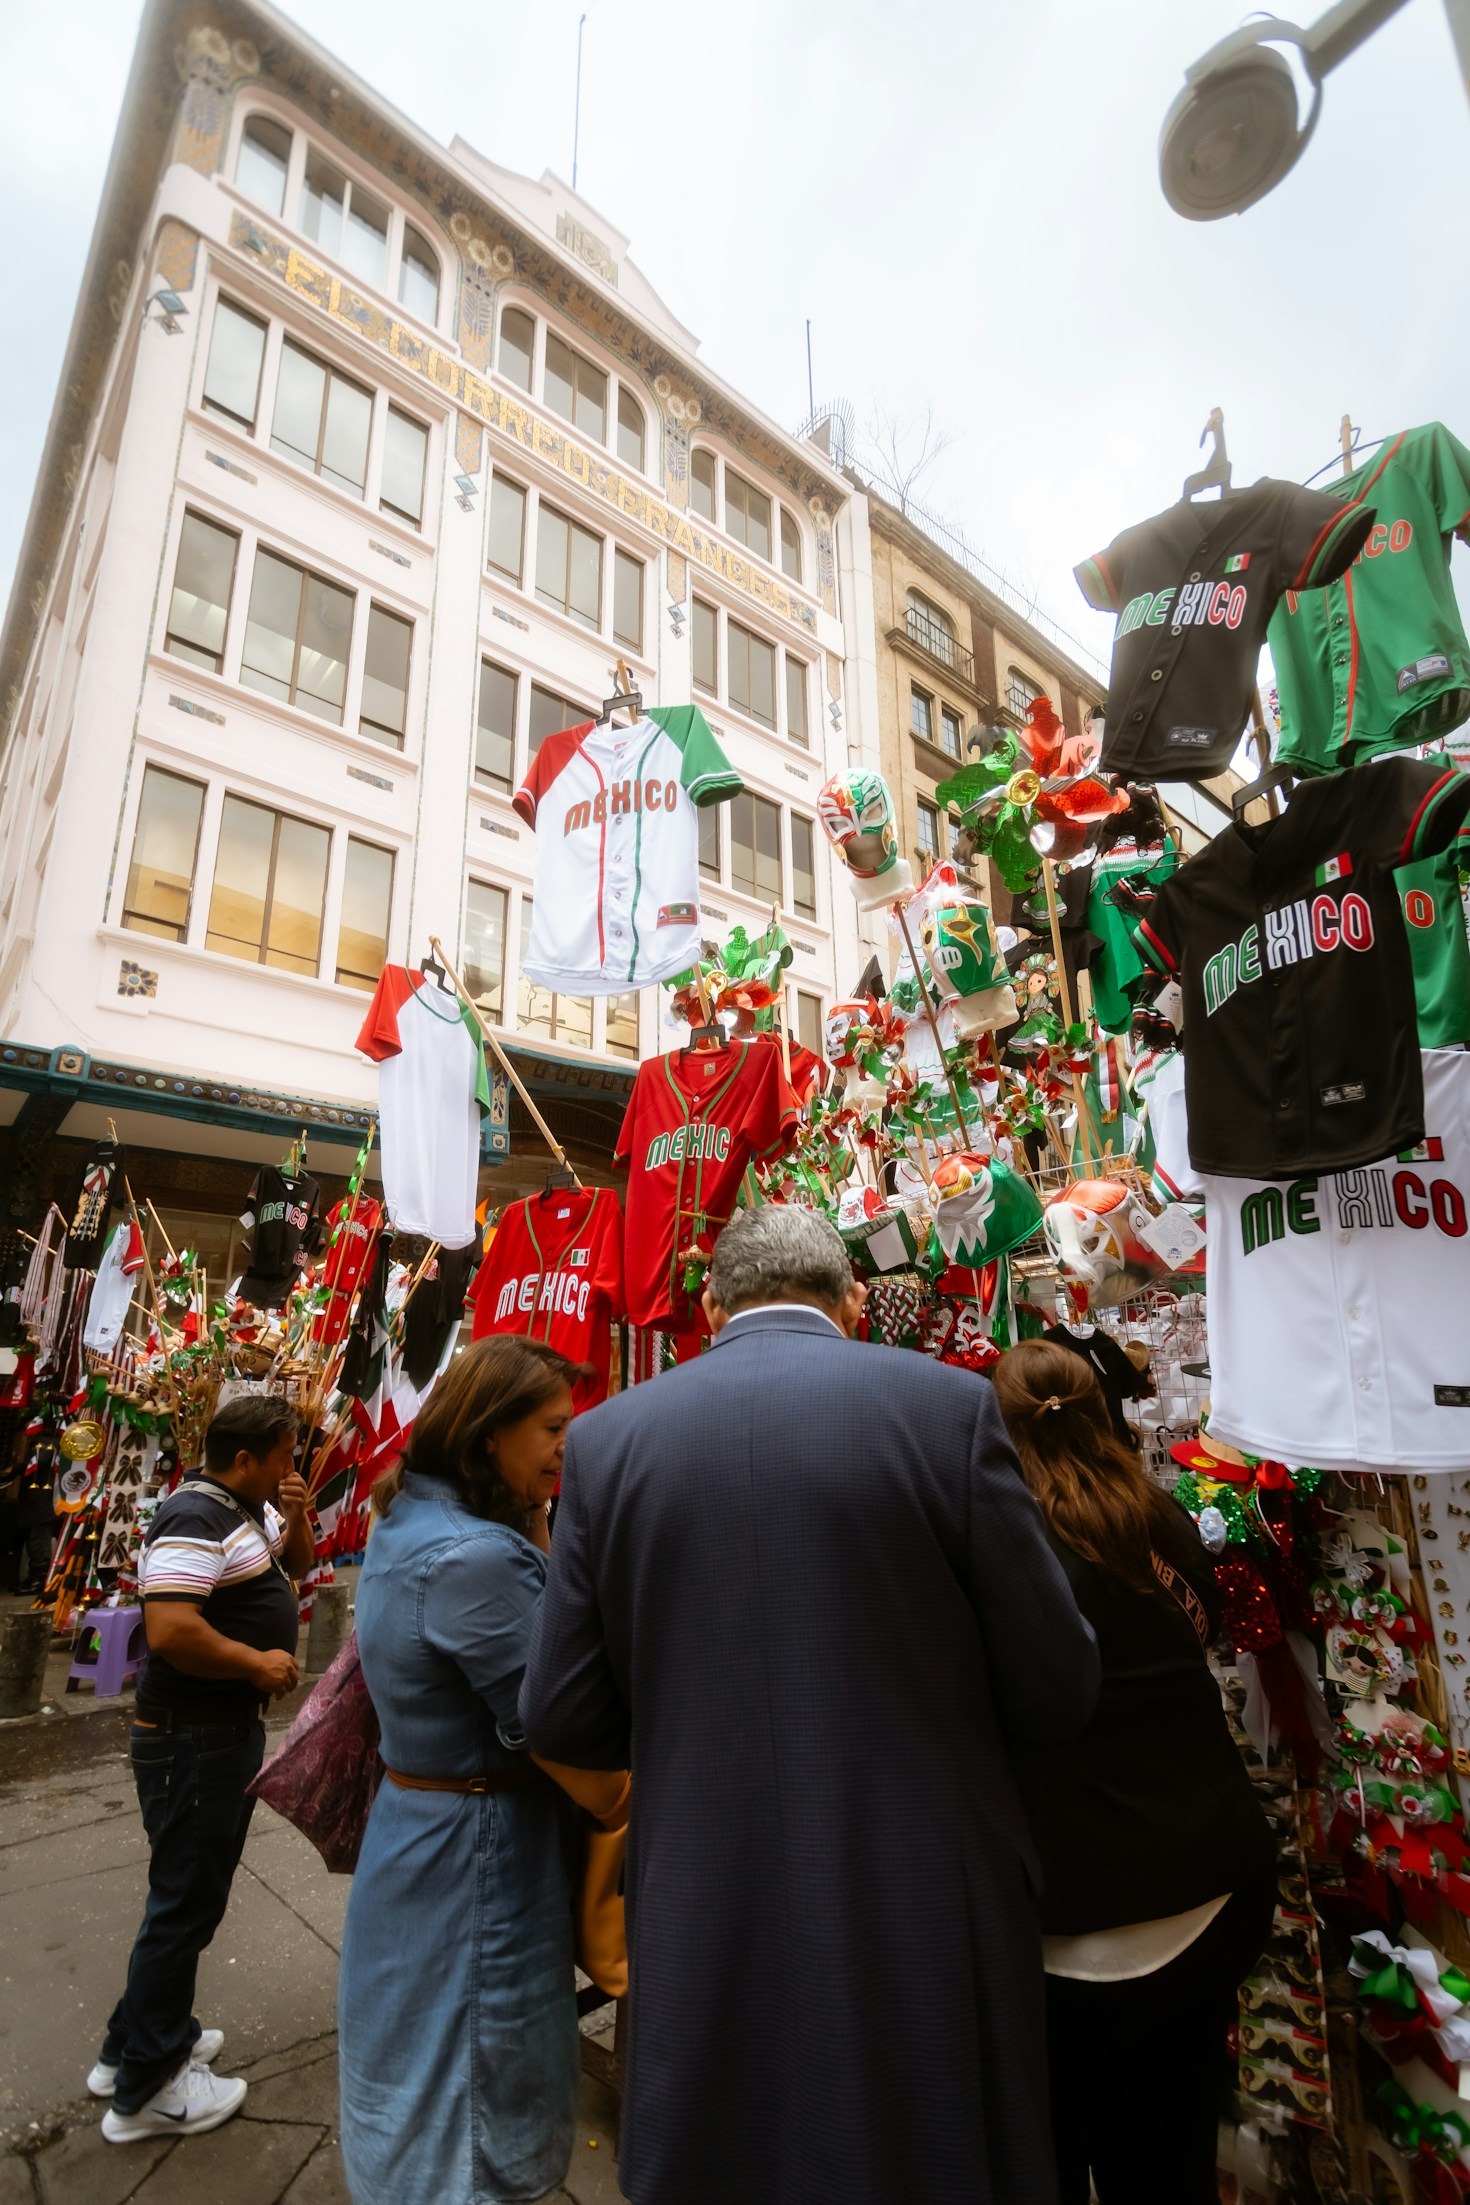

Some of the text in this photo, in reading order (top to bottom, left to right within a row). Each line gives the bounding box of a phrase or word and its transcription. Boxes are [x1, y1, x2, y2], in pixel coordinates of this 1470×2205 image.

[285, 248, 792, 619] EL CORREO FRANCES
[1113, 581, 1247, 642] MEXICO
[564, 778, 678, 838] MEXICO
[1202, 892, 1375, 1018] MEXICO
[644, 1123, 732, 1172] MEXIC
[1240, 1169, 1468, 1257] MEXICO
[494, 1271, 591, 1325] MEXICO
